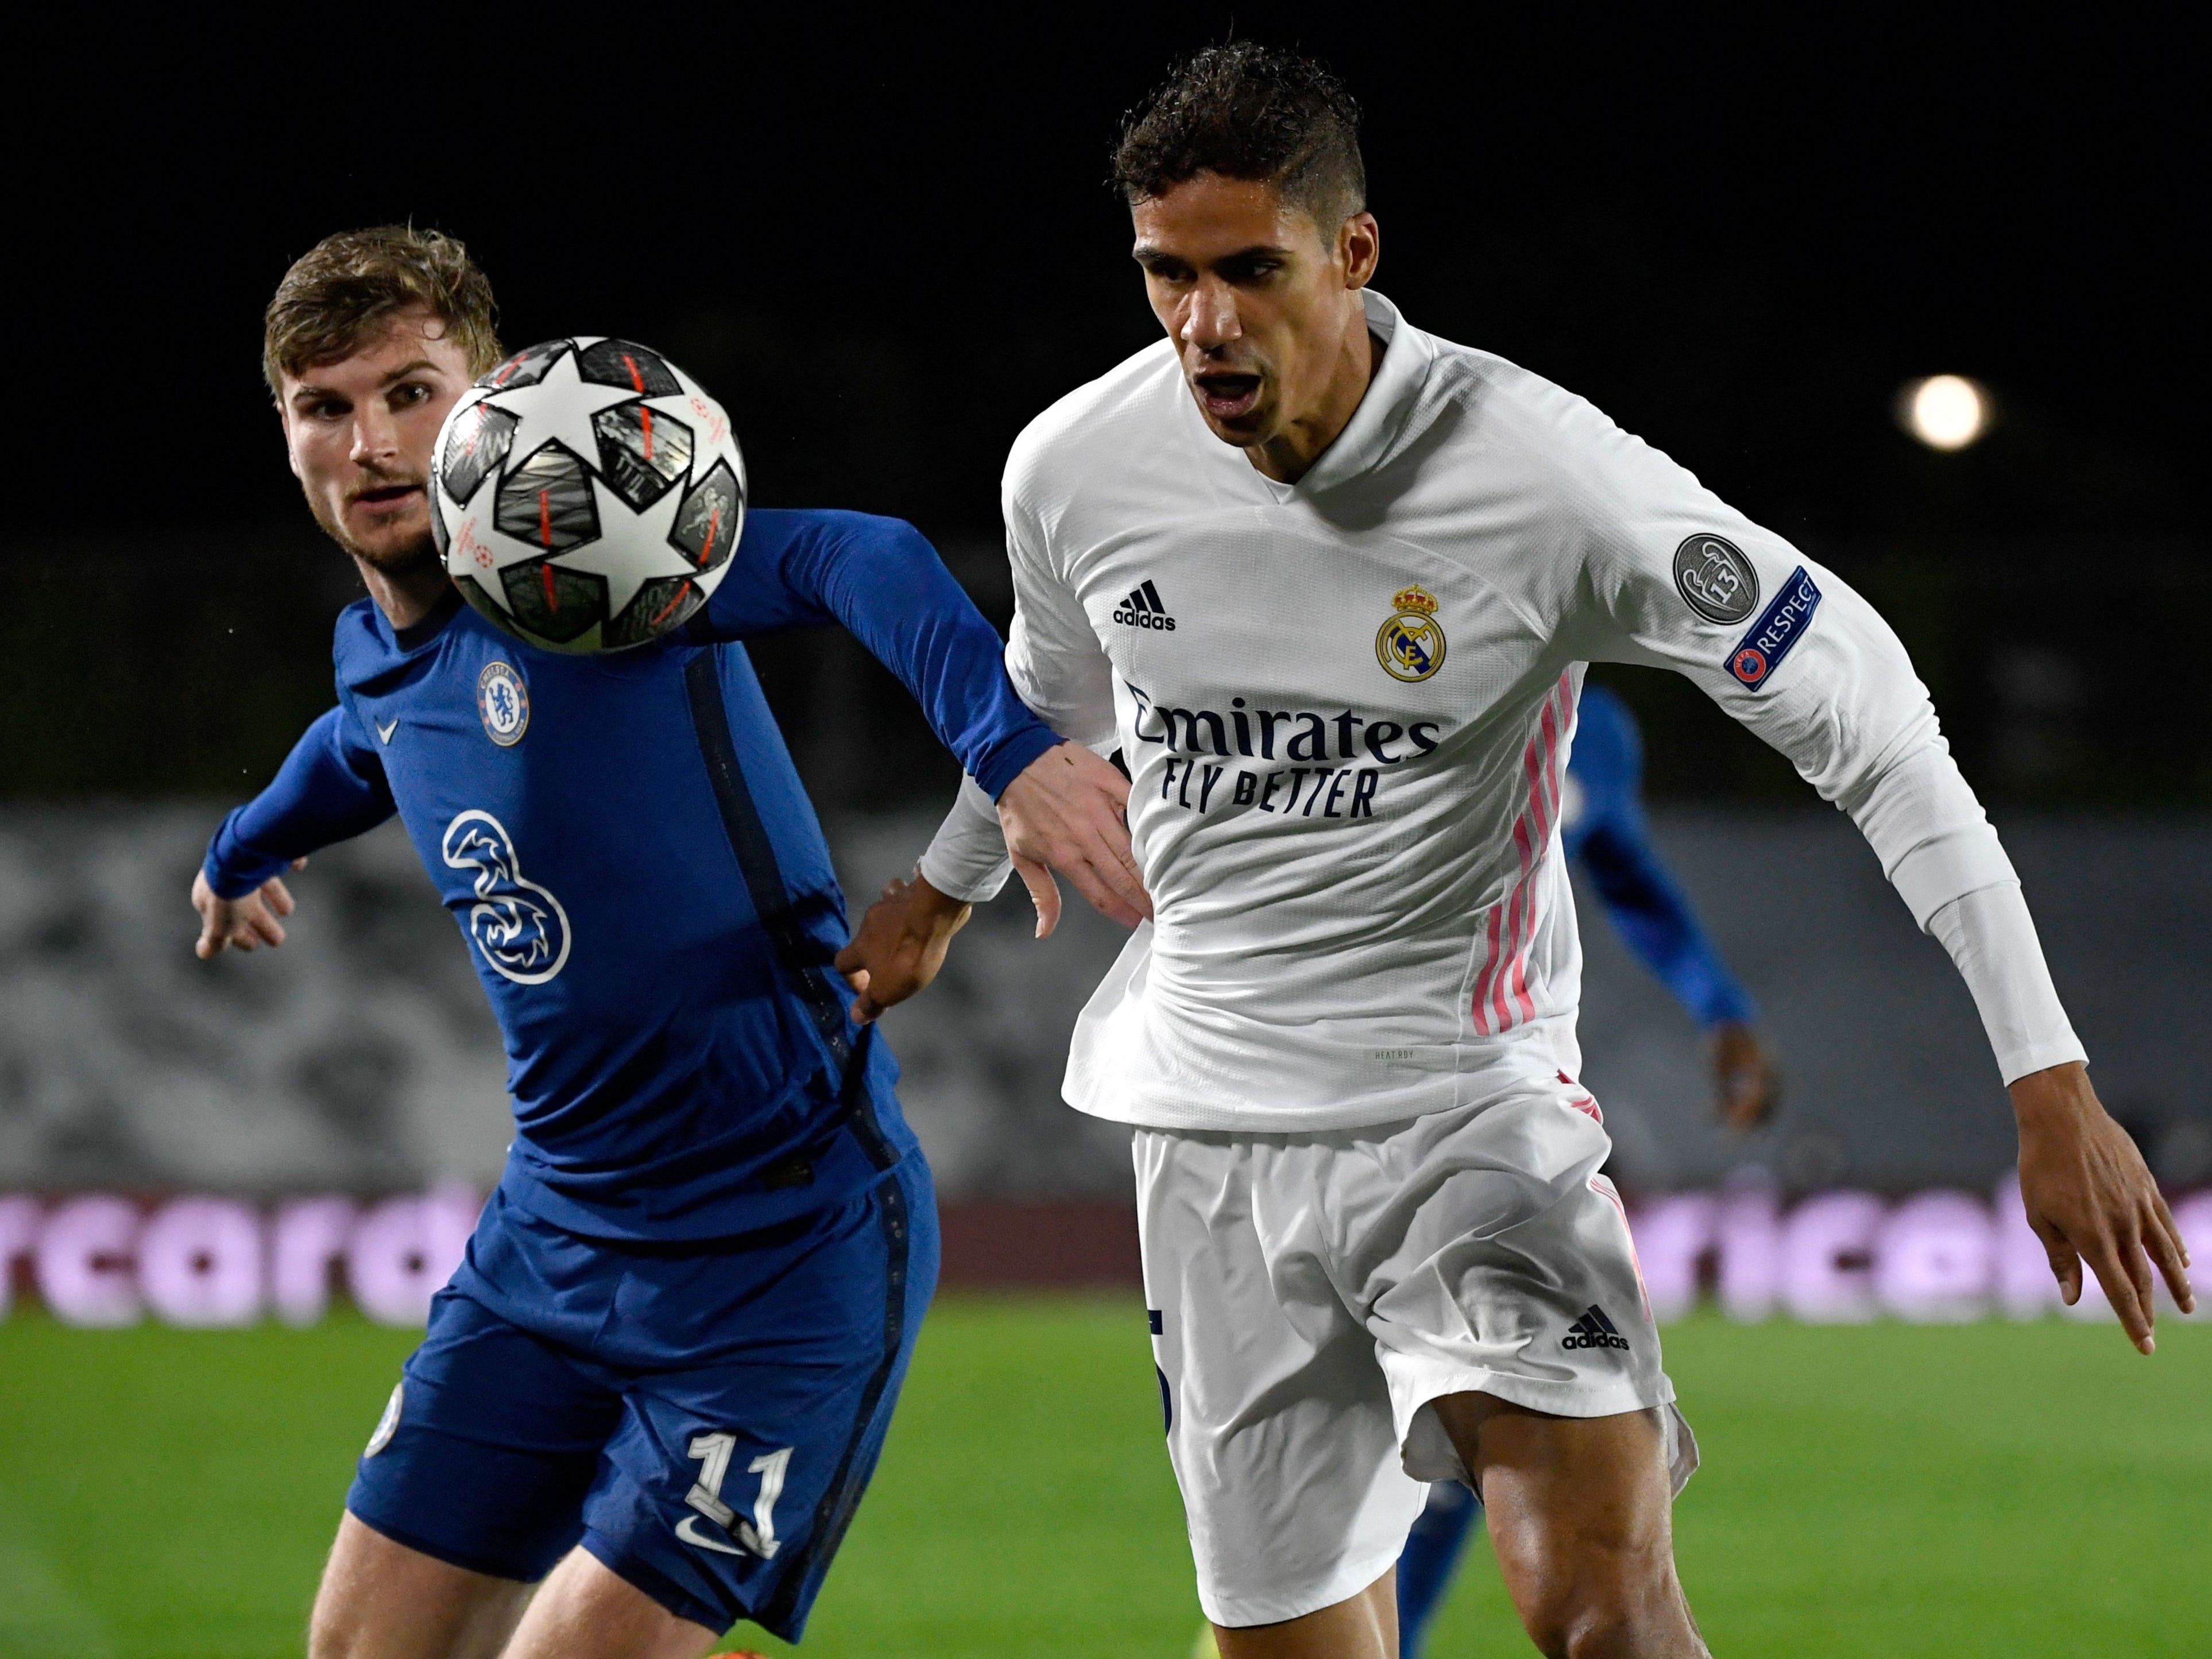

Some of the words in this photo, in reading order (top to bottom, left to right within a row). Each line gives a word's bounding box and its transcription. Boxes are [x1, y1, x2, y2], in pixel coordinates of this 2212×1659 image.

[1710, 569, 1739, 604] 13
[1757, 575, 1815, 654] RESPECT
[1113, 608, 1176, 631] adidas
[1123, 680, 1440, 764] Emirates
[1161, 756, 1224, 814] FLY
[1232, 768, 1379, 818] BETTER
[1561, 1332, 1630, 1351] adidas
[685, 1432, 795, 1560] 11
